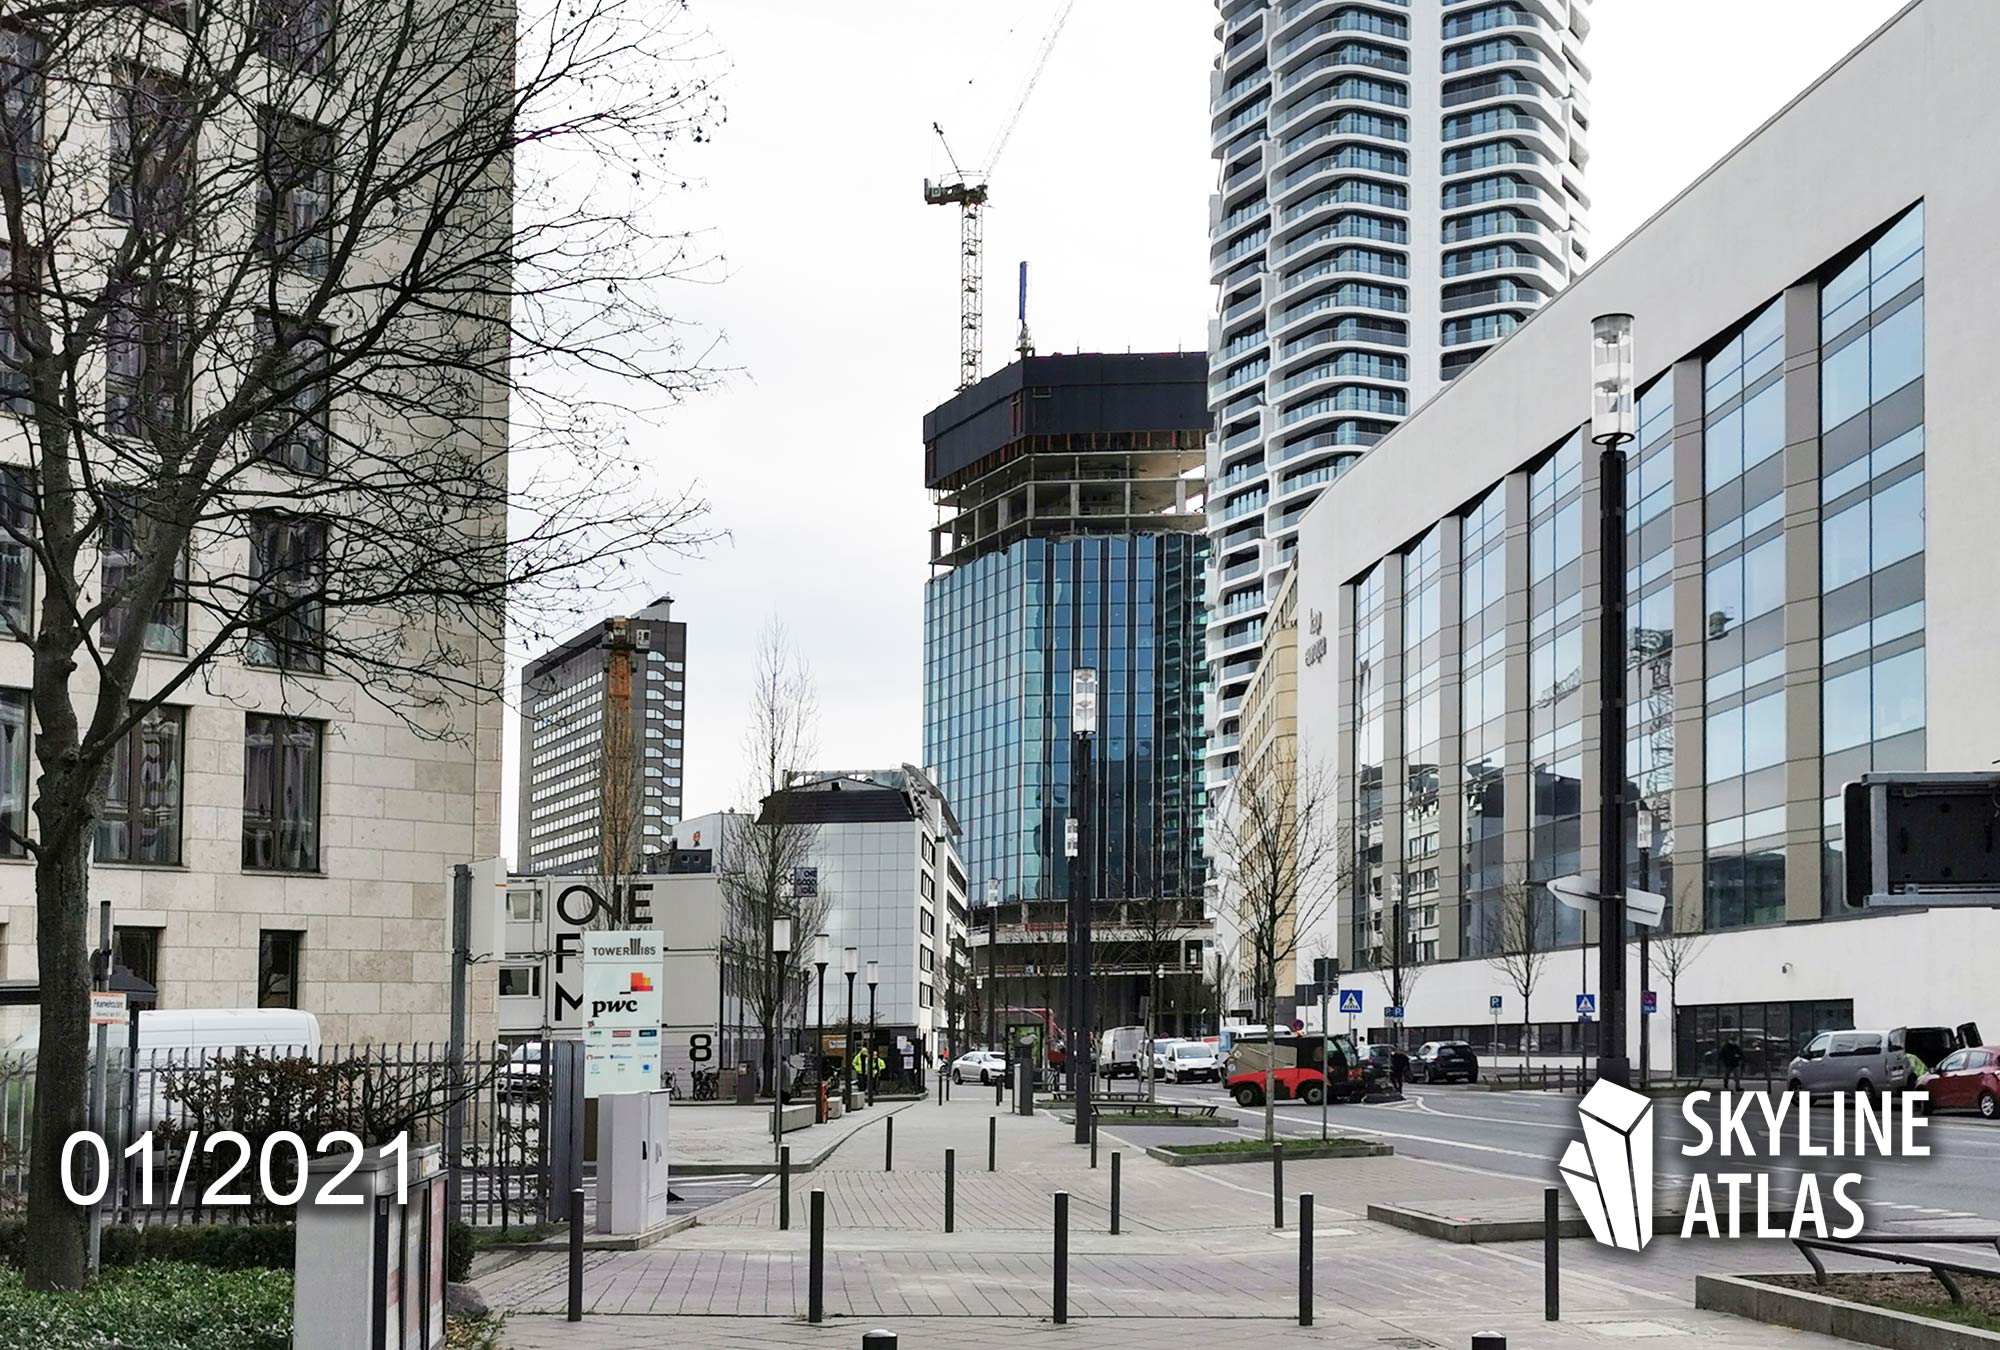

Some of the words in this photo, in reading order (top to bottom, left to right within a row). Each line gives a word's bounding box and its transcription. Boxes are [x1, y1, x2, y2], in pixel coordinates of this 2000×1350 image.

[557, 884, 654, 925] ONE
[592, 947, 630, 956] TOWER
[592, 1000, 638, 1018] pwc
[689, 1034, 712, 1062] 8
